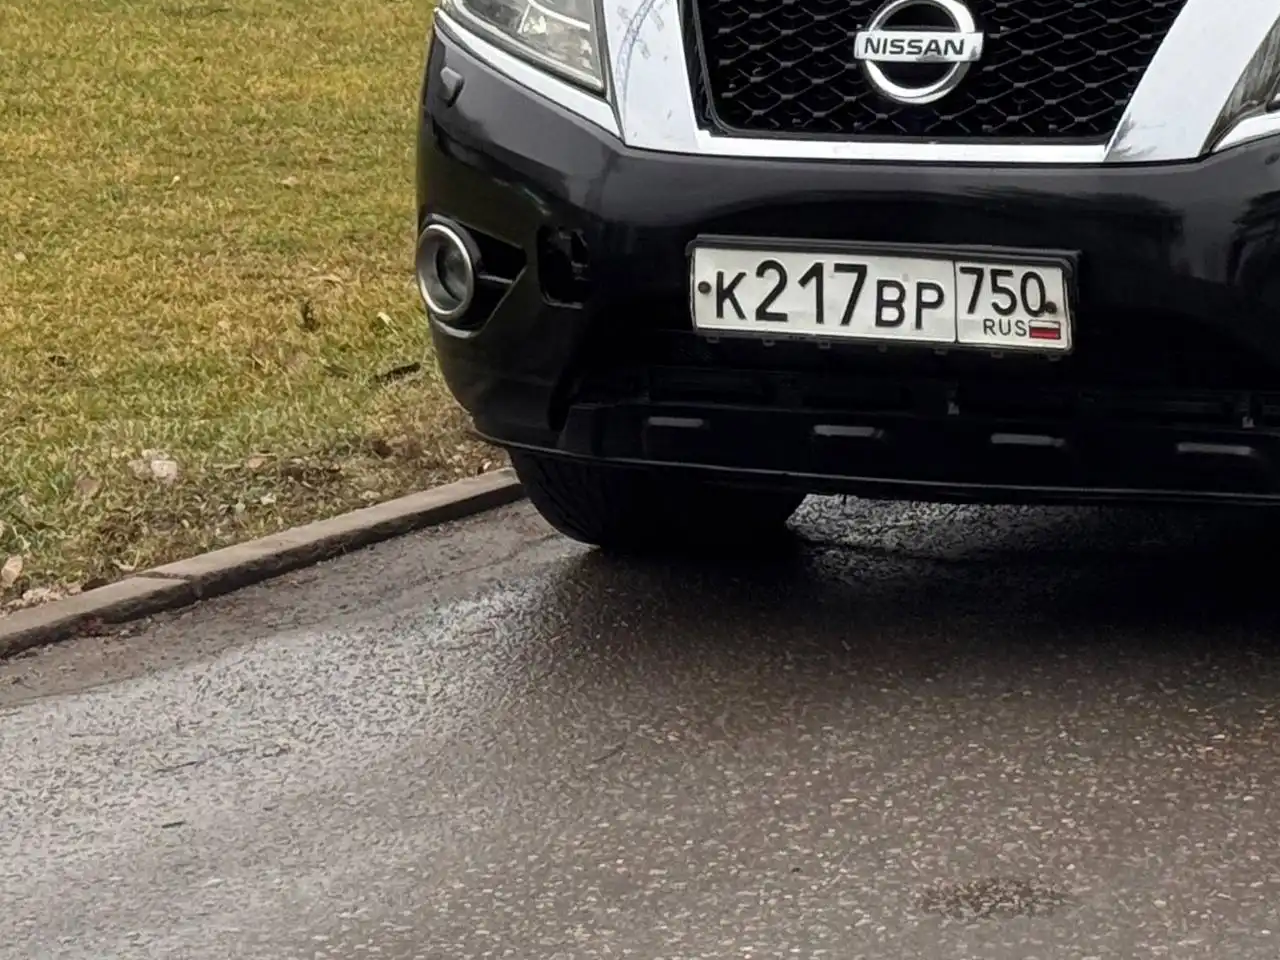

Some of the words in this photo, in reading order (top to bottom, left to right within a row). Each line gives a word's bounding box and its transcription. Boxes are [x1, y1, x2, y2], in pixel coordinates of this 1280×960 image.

[864, 37, 966, 56] NISSAN
[958, 266, 1048, 318] 750
[983, 318, 1028, 337] RUS
